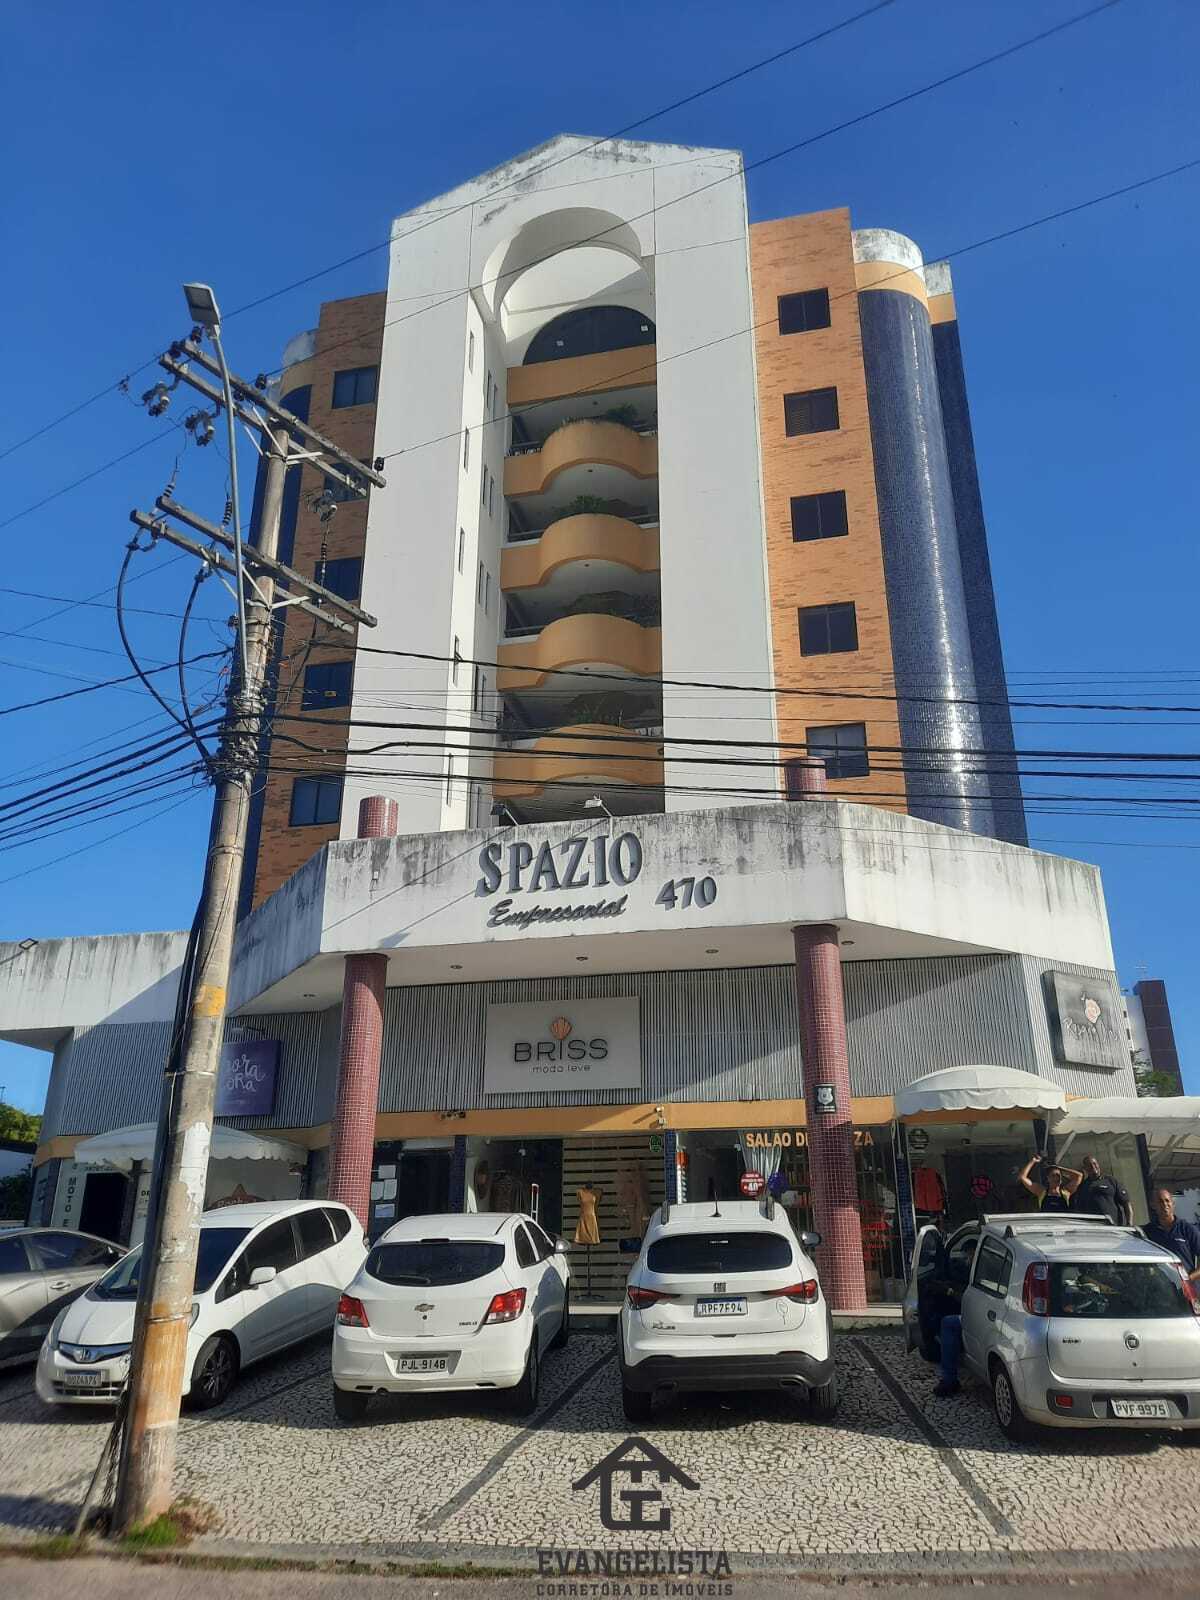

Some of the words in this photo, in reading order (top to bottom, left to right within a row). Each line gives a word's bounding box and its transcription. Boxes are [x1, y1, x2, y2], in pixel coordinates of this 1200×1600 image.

[475, 832, 643, 898] SPAZIO
[486, 893, 629, 931] Empresarial
[654, 876, 717, 912] 470
[514, 1038, 608, 1062] BRISS
[530, 1064, 564, 1074] moda
[567, 1064, 592, 1073] leve
